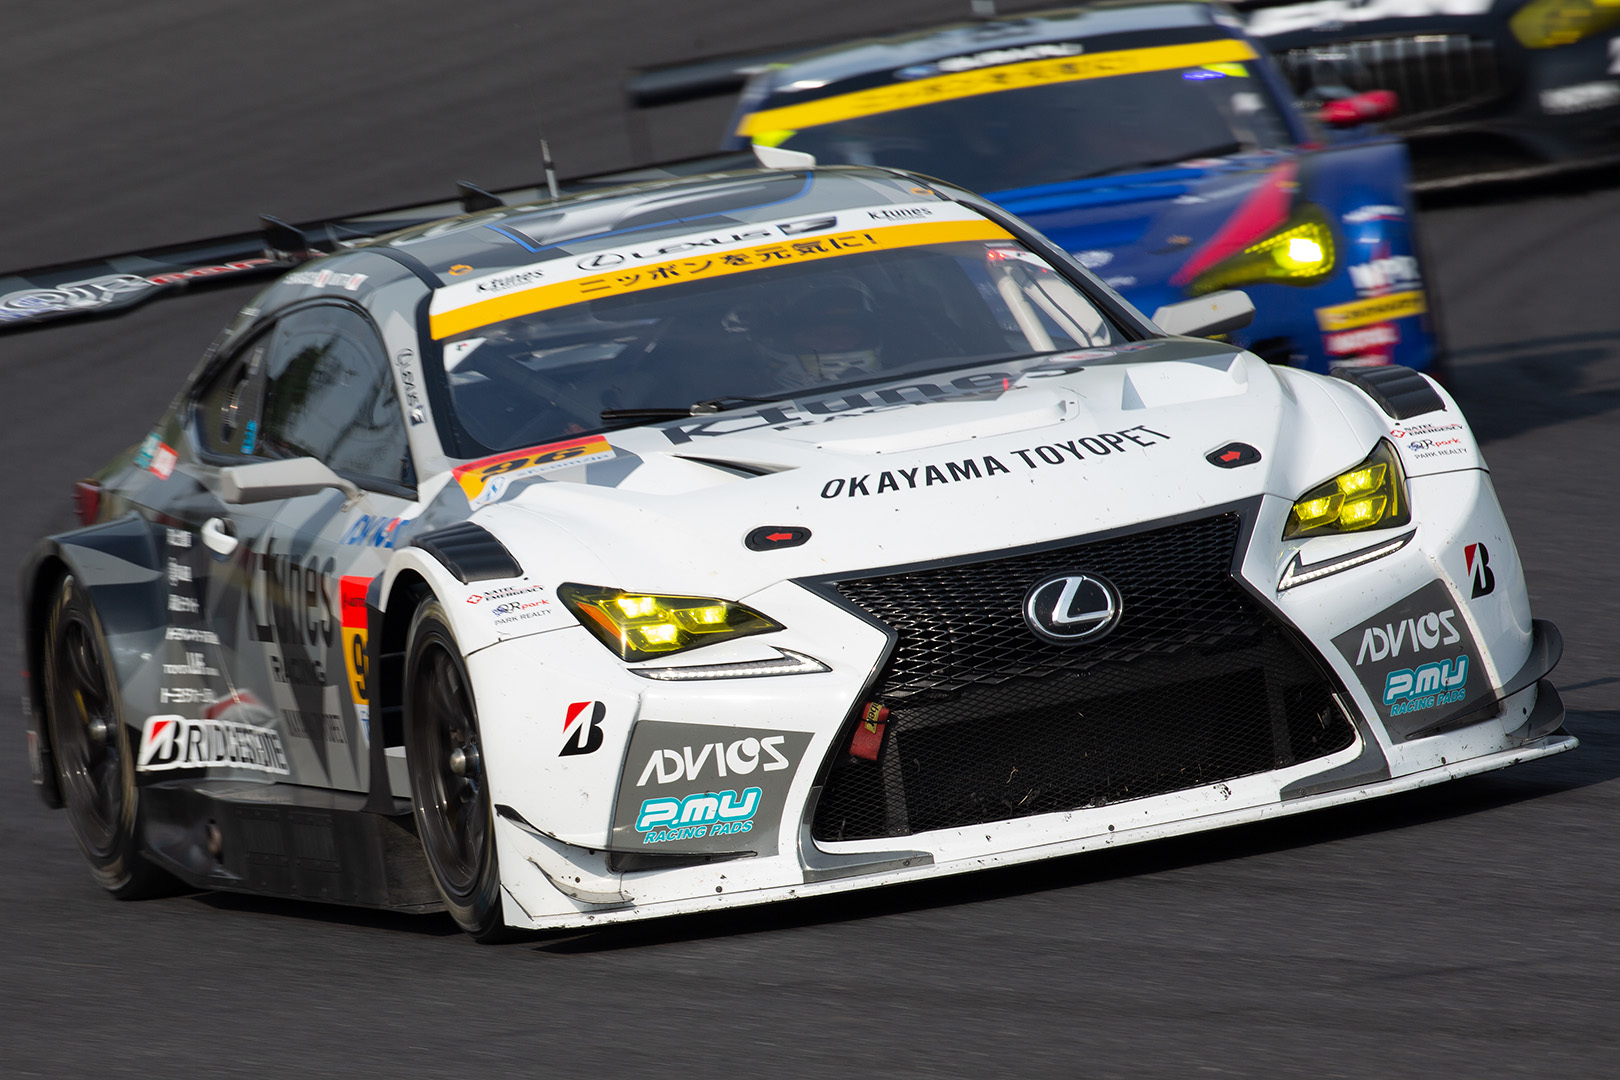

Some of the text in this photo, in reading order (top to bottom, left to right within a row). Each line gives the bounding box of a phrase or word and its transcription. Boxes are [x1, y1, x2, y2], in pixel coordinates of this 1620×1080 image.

[631, 229, 771, 258] LEXUS
[820, 425, 1171, 498] OKAYAMA TOYOPET
[494, 609, 552, 626] PARK REALTY
[1390, 688, 1466, 717] RACING PADS
[643, 820, 754, 844] RACING PADS
